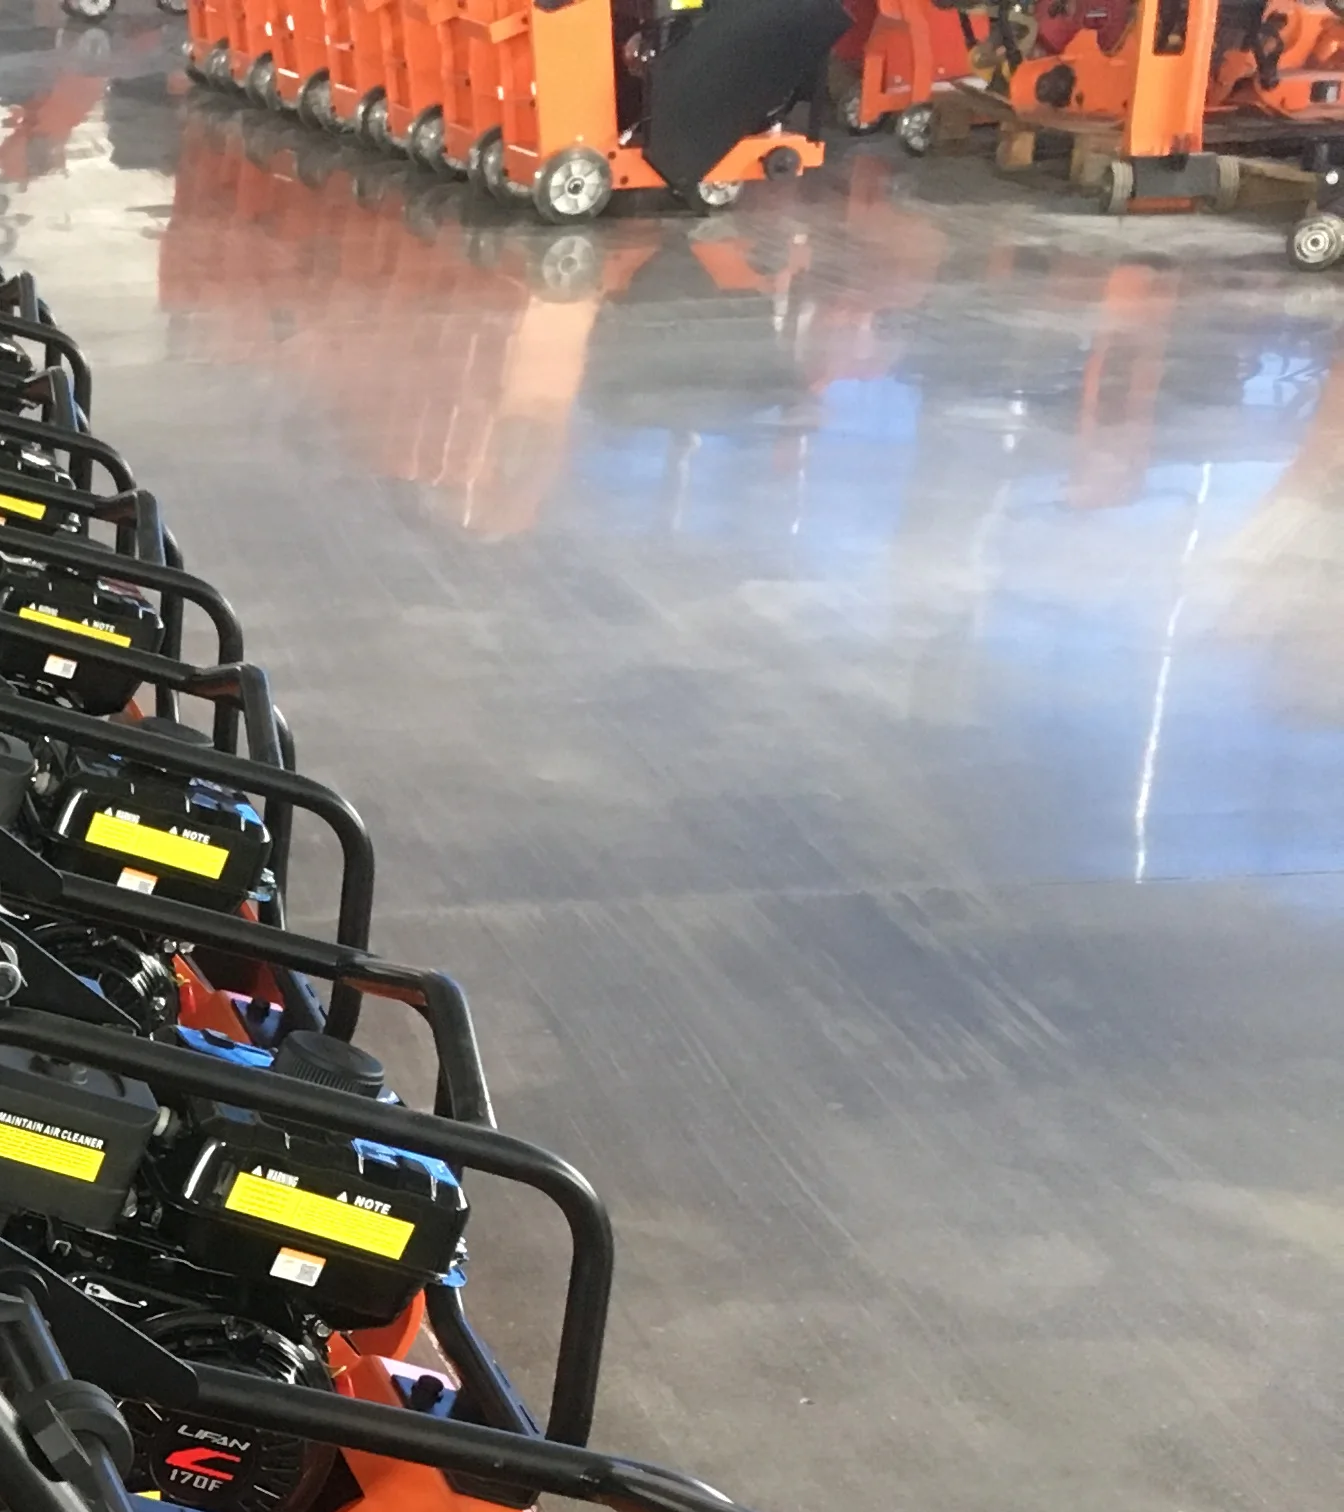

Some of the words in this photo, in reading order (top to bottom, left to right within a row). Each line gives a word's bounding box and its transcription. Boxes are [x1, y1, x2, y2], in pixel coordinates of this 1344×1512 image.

[182, 829, 211, 845] NOTE
[42, 1124, 61, 1138] AIR
[60, 1129, 104, 1150] CLEANER
[354, 1195, 392, 1215] NOTE
[177, 1424, 251, 1451] LIFAN
[169, 1468, 224, 1491] 170F
